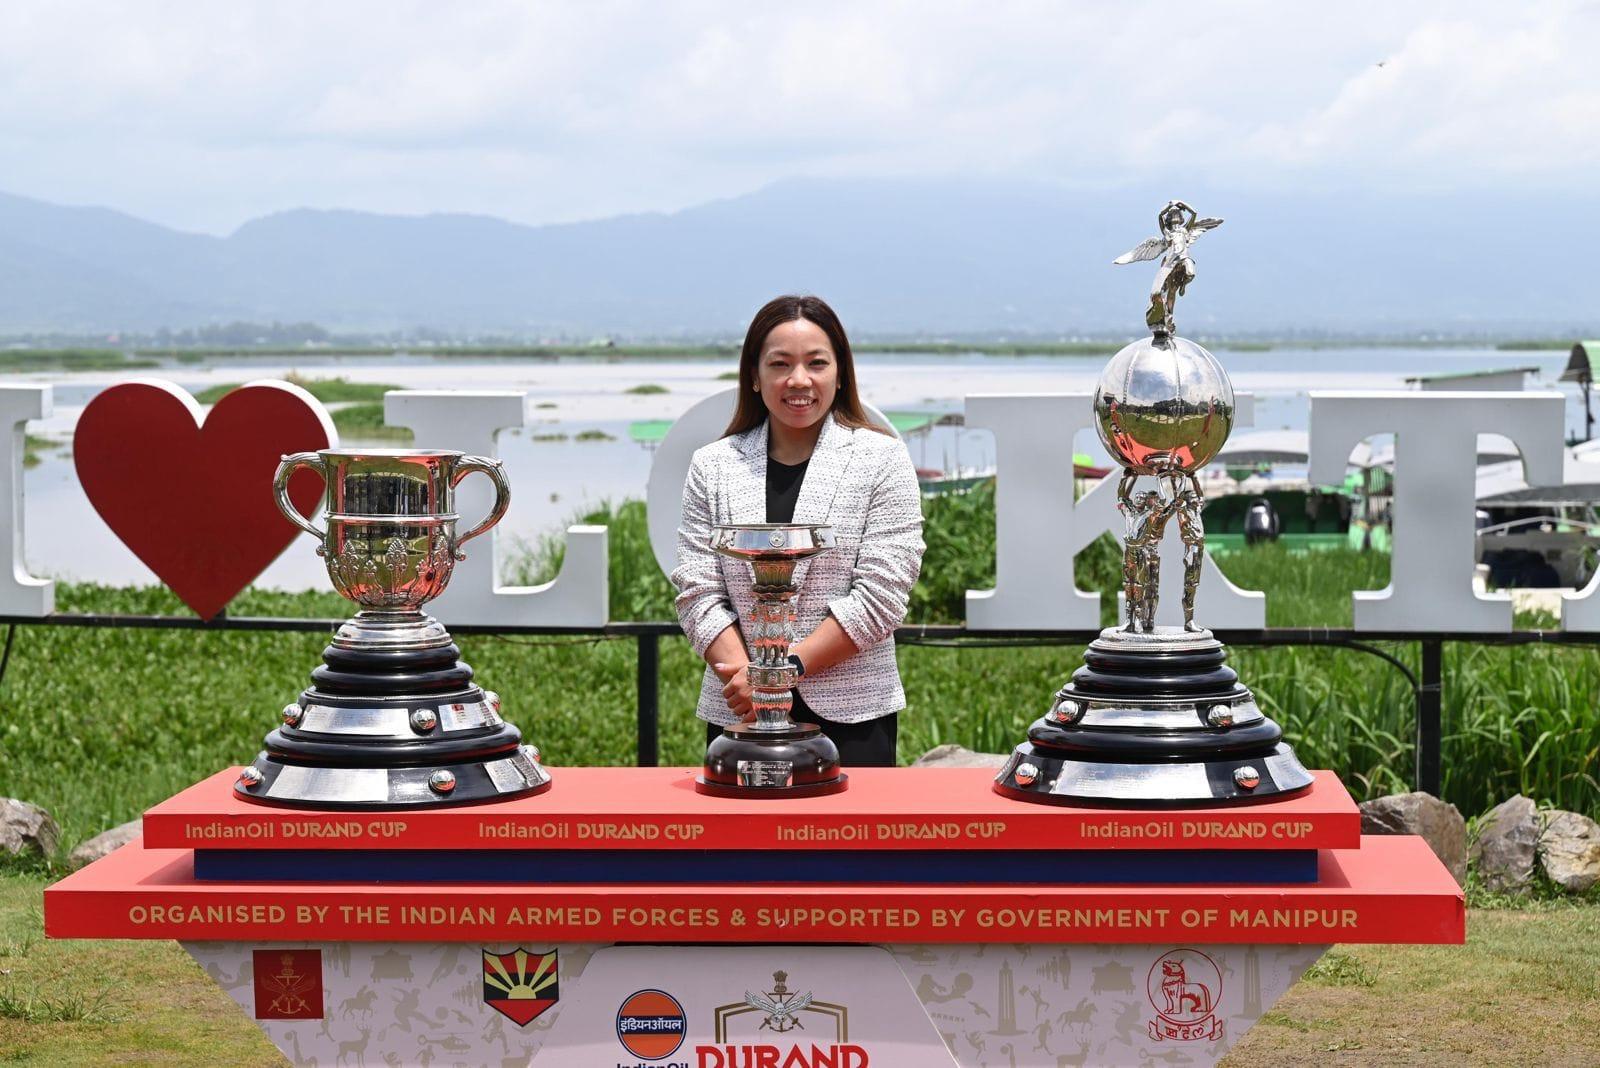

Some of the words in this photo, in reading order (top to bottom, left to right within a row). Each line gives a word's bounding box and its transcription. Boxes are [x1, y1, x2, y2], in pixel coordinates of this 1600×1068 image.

[187, 823, 273, 838] IndianOil
[282, 822, 362, 838] DURAND
[368, 822, 407, 837] CUP
[479, 823, 568, 839] IndianOil
[577, 823, 659, 839] DURAND
[664, 824, 704, 839] CUP
[777, 825, 868, 840] IndianOil
[877, 824, 960, 840] DURAND
[966, 823, 1005, 838] CUP
[1080, 823, 1173, 839] IndianOil
[1182, 823, 1266, 839] DURAND
[1272, 822, 1313, 838] CUP
[129, 906, 285, 923] ORGANISED
[297, 906, 328, 922] BY
[339, 906, 390, 923] THE
[401, 907, 494, 924] INDIAN
[506, 908, 601, 925] ARMED
[613, 909, 719, 926] FORCES
[730, 909, 746, 926] &
[757, 909, 920, 927] SUPPORTED
[932, 910, 965, 927] BY
[977, 910, 1169, 927] GOVERNMENT
[1181, 910, 1218, 927] OF
[1230, 910, 1358, 927] MANIPUR
[696, 1043, 869, 1068] DURAND
